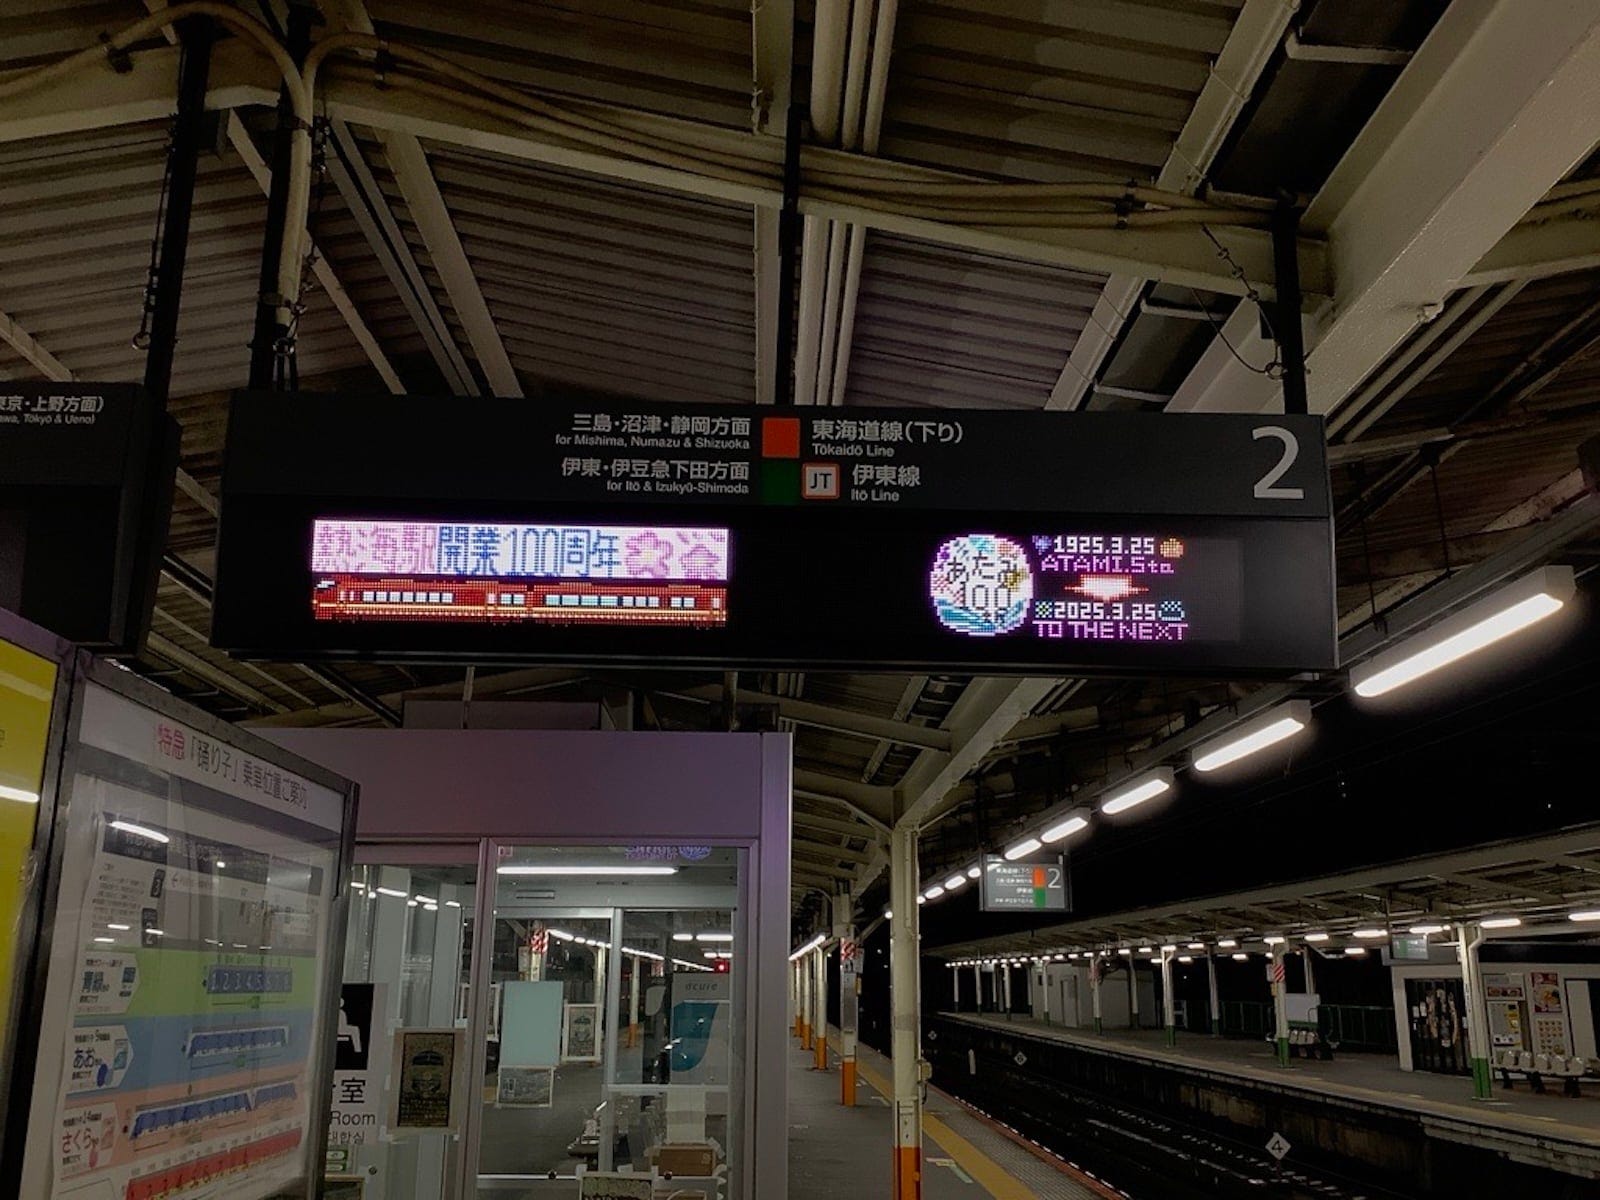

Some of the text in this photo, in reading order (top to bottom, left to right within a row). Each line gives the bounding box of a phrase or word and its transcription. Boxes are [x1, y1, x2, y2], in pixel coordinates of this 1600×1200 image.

[54, 413, 63, 425] &
[571, 412, 752, 436] 三島・沼津・静岡方面
[555, 433, 751, 450] for Mishima, Numazu & Shizuoka
[811, 419, 964, 444] 東海道線(下り)
[811, 441, 896, 458] Tōkaidō Line
[560, 456, 751, 481] 伊東・伊豆急下田方面
[1251, 424, 1306, 500] 2
[810, 472, 833, 489] JT
[851, 463, 922, 488] 伊東線
[606, 479, 622, 492] for
[643, 480, 653, 493] &
[870, 488, 901, 502] Line
[1053, 535, 1155, 555] 1925.3.25
[1053, 601, 1156, 621] 2025.3.25
[1032, 620, 1189, 640] TO THE NEXT
[1047, 867, 1062, 889] 2
